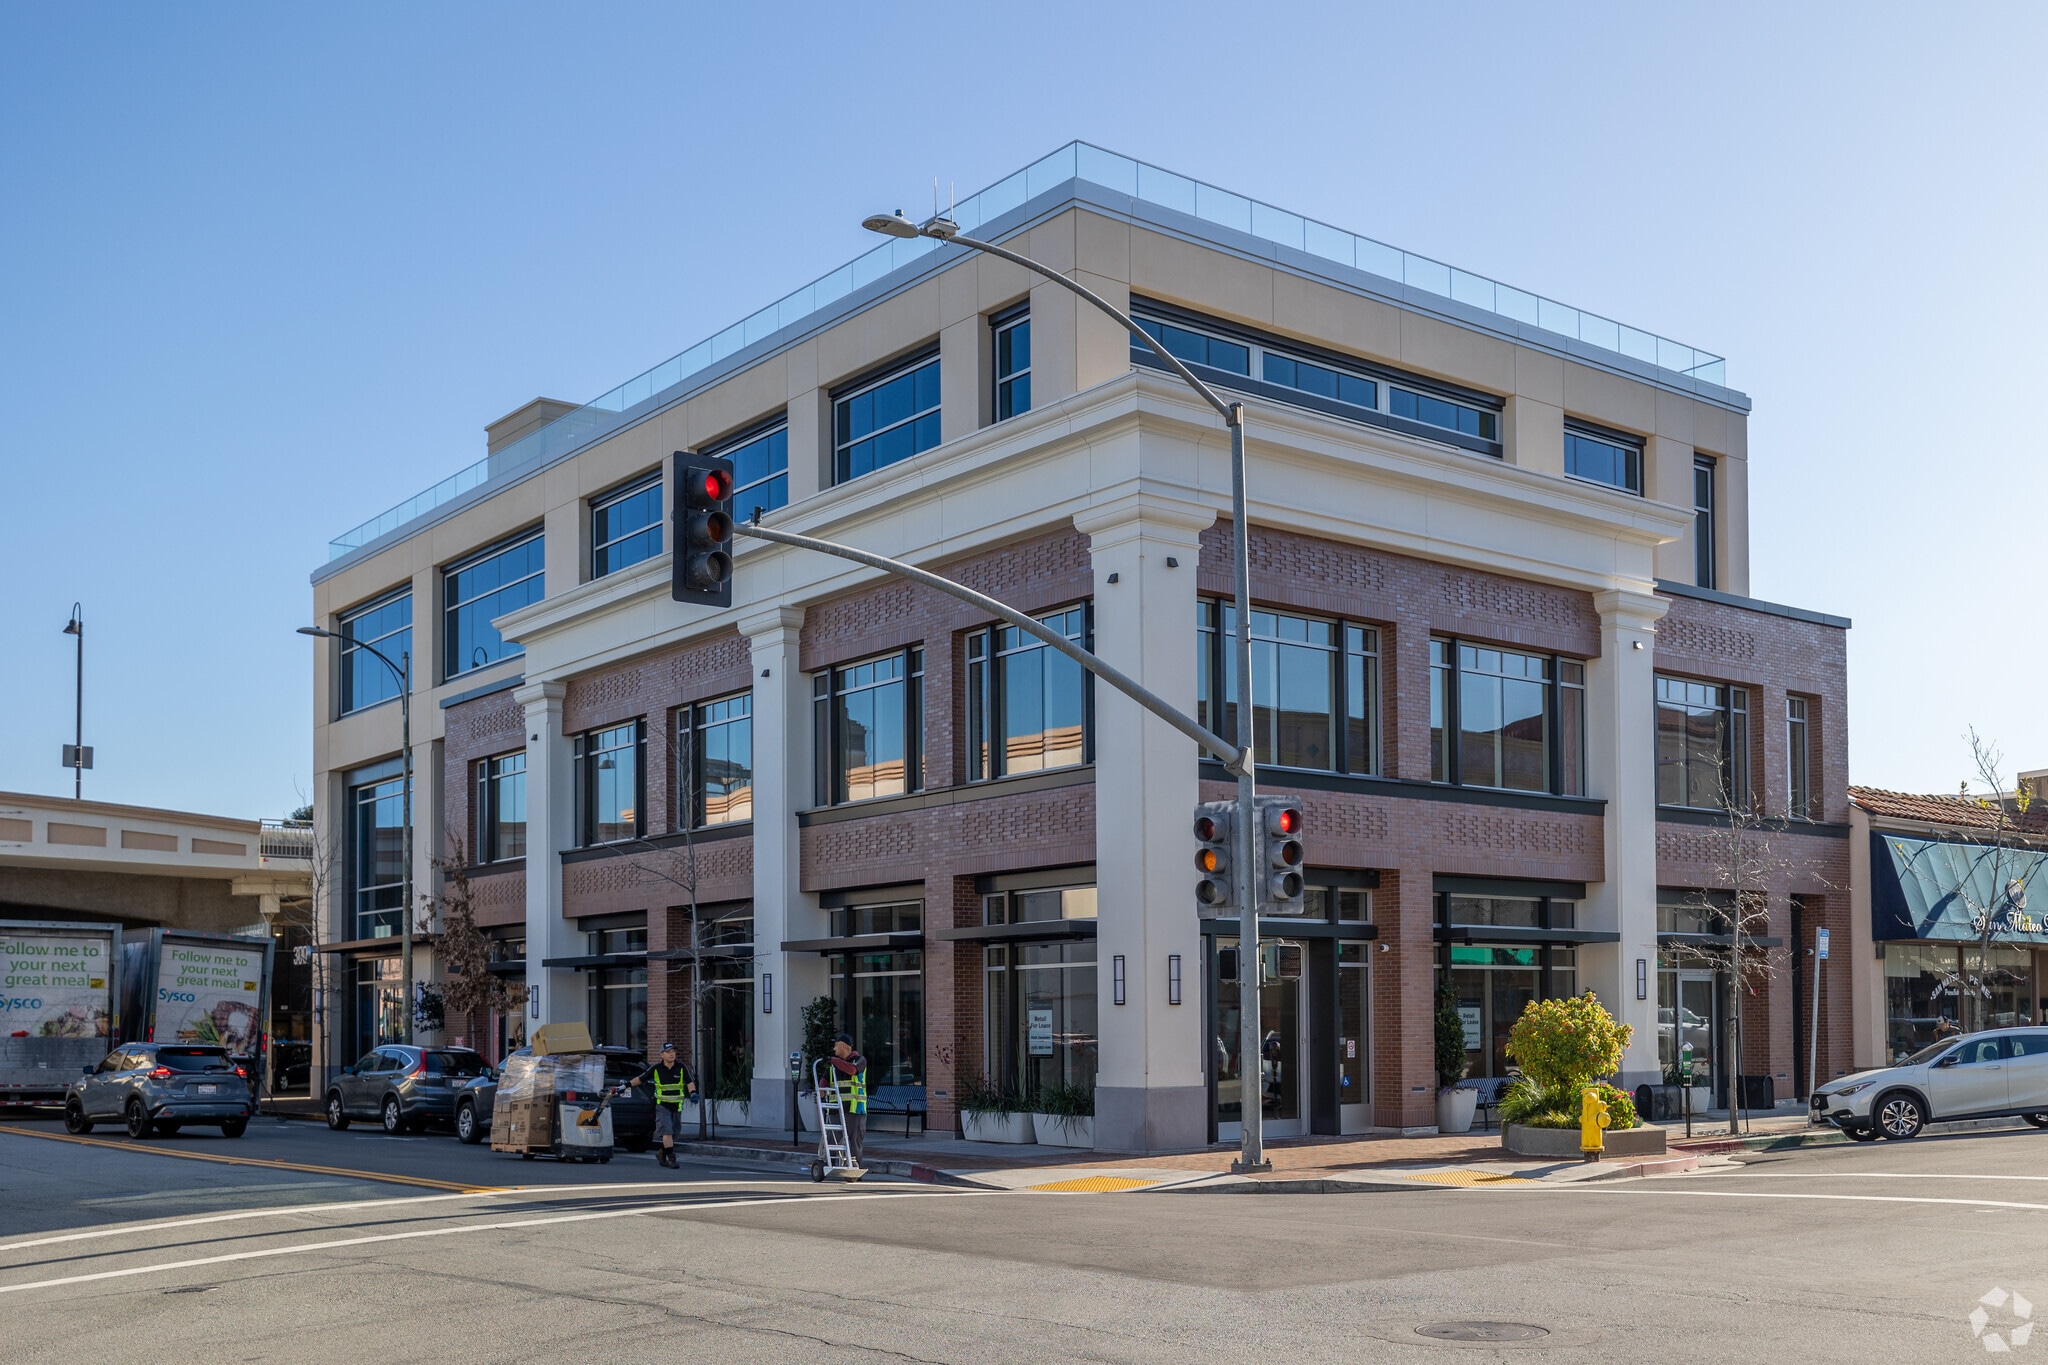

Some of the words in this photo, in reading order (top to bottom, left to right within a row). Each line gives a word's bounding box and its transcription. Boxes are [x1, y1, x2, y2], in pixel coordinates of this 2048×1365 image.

[53, 946, 78, 956] me
[82, 945, 99, 957] to
[172, 949, 211, 963] Follow
[214, 955, 233, 965] me
[236, 956, 248, 967] to
[10, 960, 47, 973] your
[51, 960, 86, 972] next
[181, 964, 209, 975] your
[211, 966, 238, 977] next
[5, 974, 48, 988] great
[52, 974, 90, 986] meal
[176, 976, 208, 987] great
[211, 979, 240, 989] meal
[159, 988, 195, 1003] Sysco
